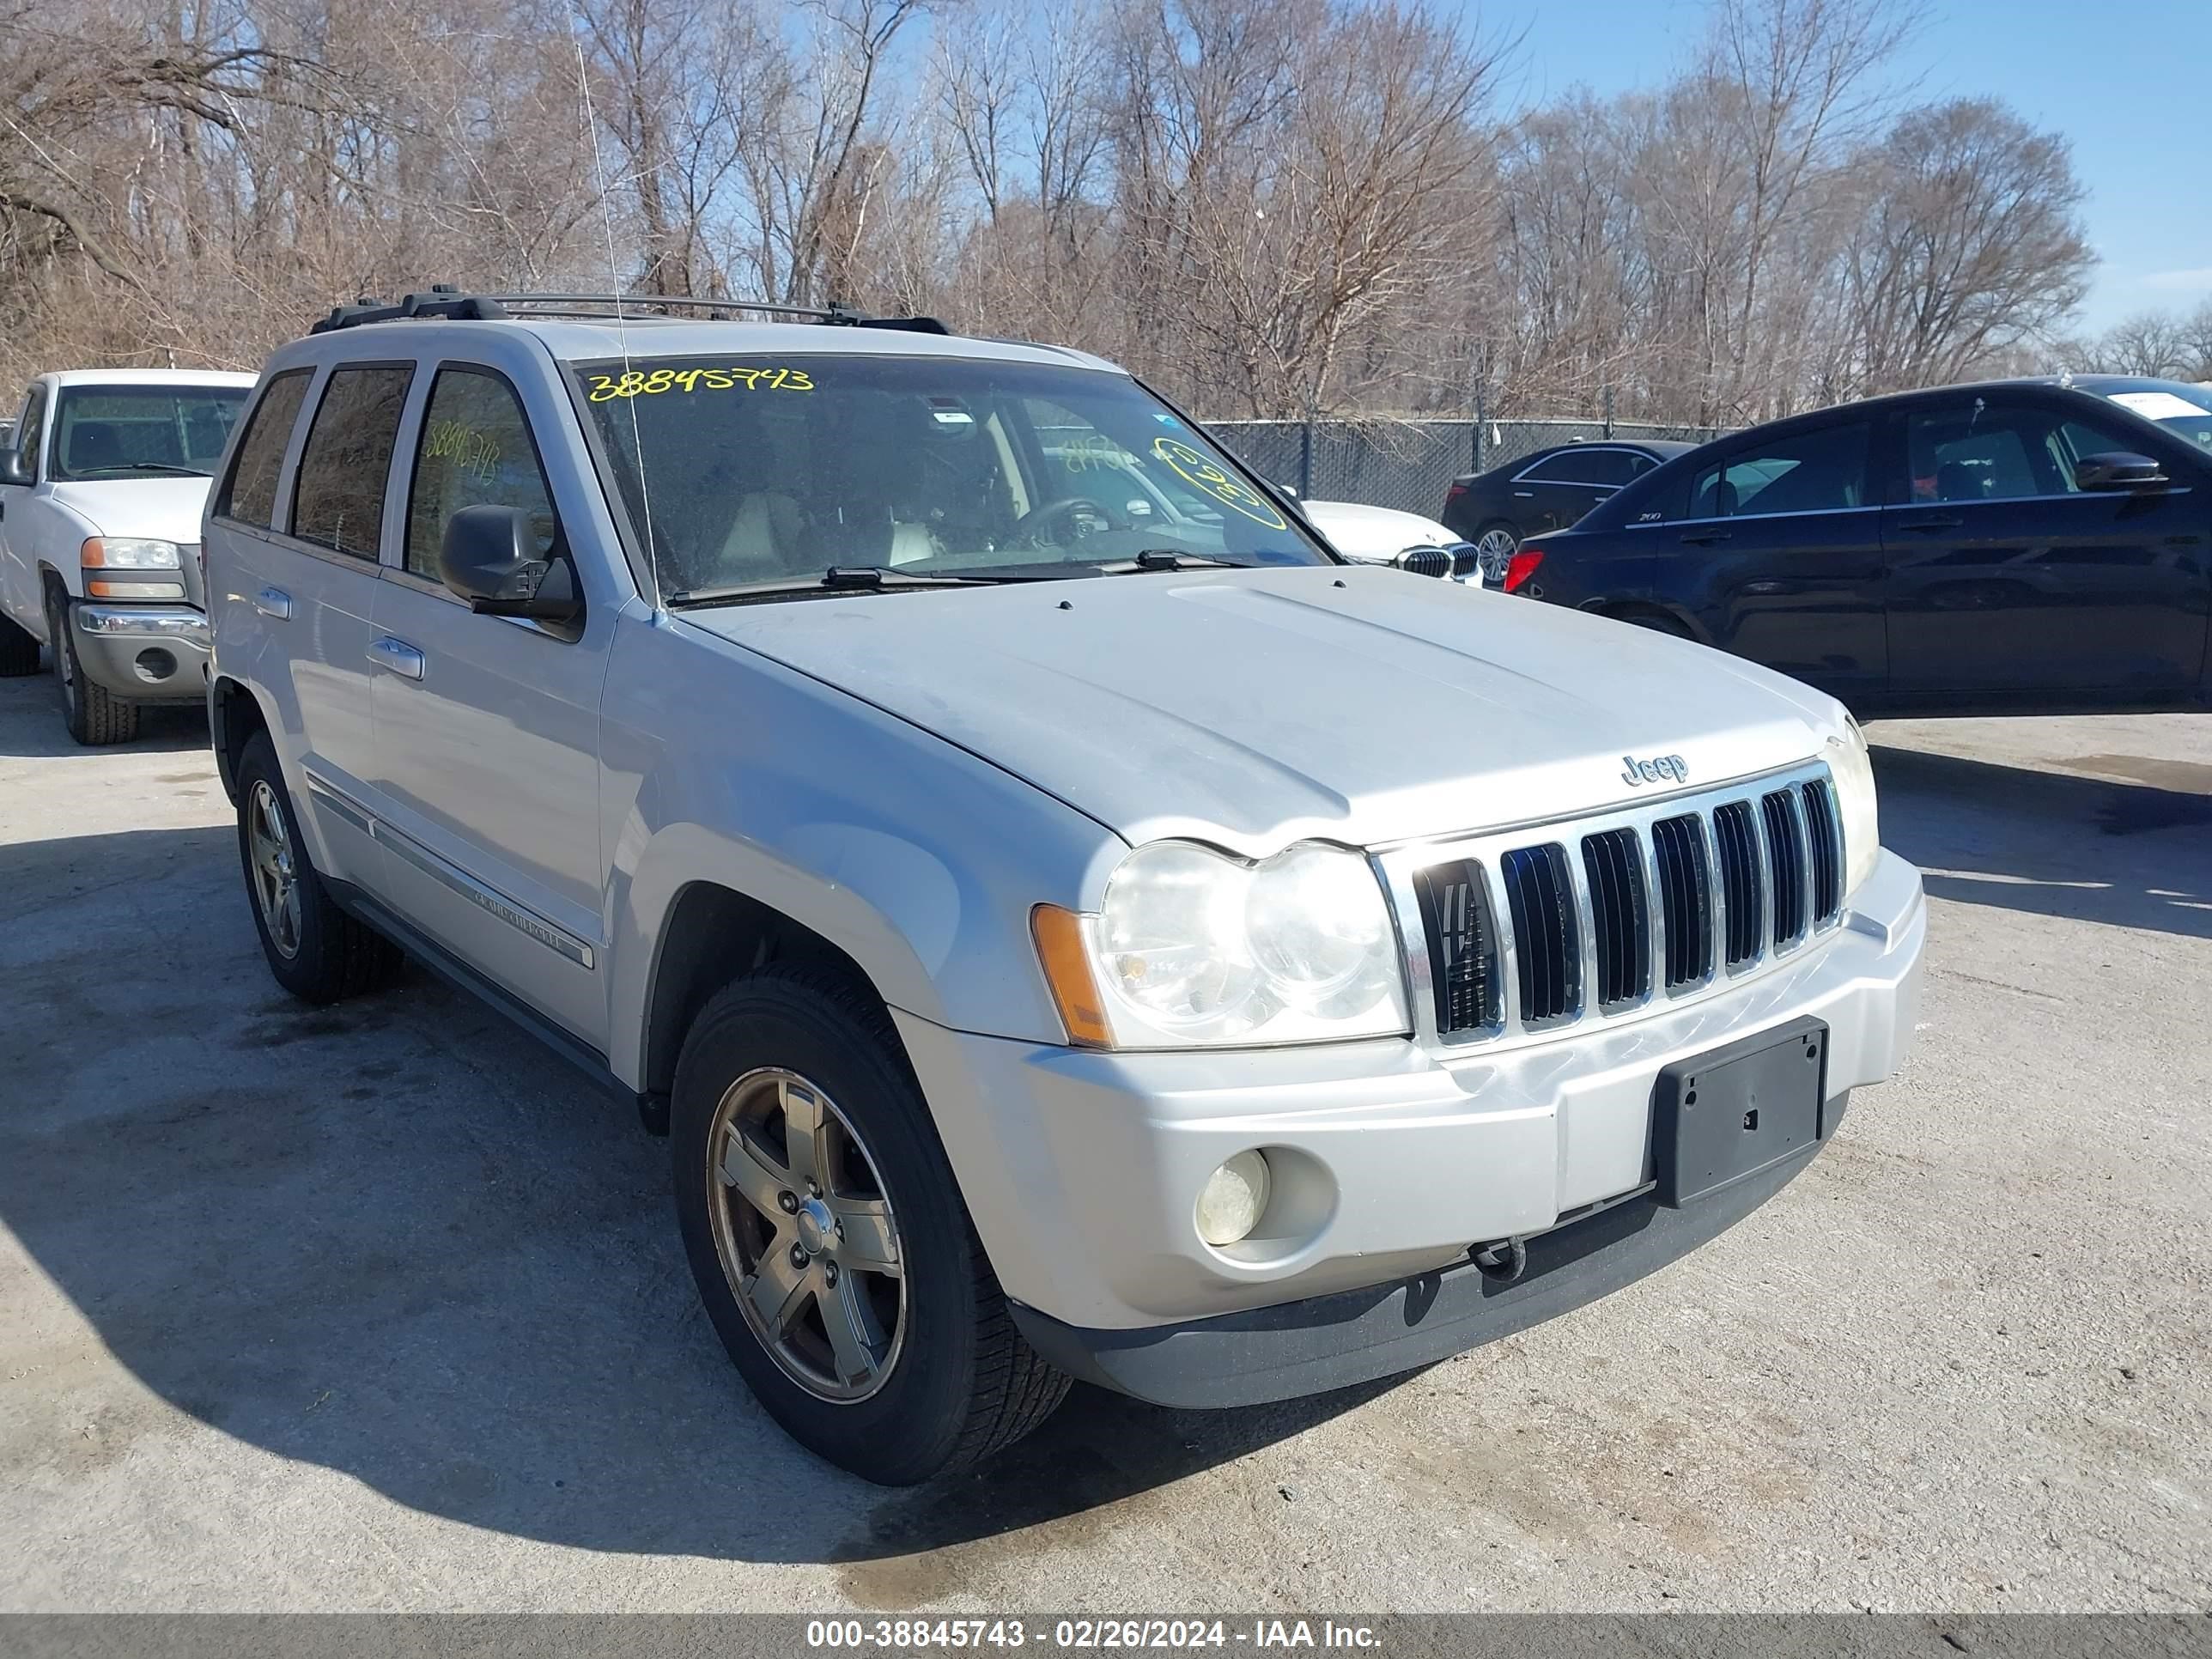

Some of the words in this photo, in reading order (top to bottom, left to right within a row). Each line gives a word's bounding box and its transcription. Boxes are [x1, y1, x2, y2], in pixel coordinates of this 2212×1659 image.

[589, 368, 815, 402] 38845743
[1638, 513, 1662, 521] 200
[1621, 755, 1688, 787] Jeep
